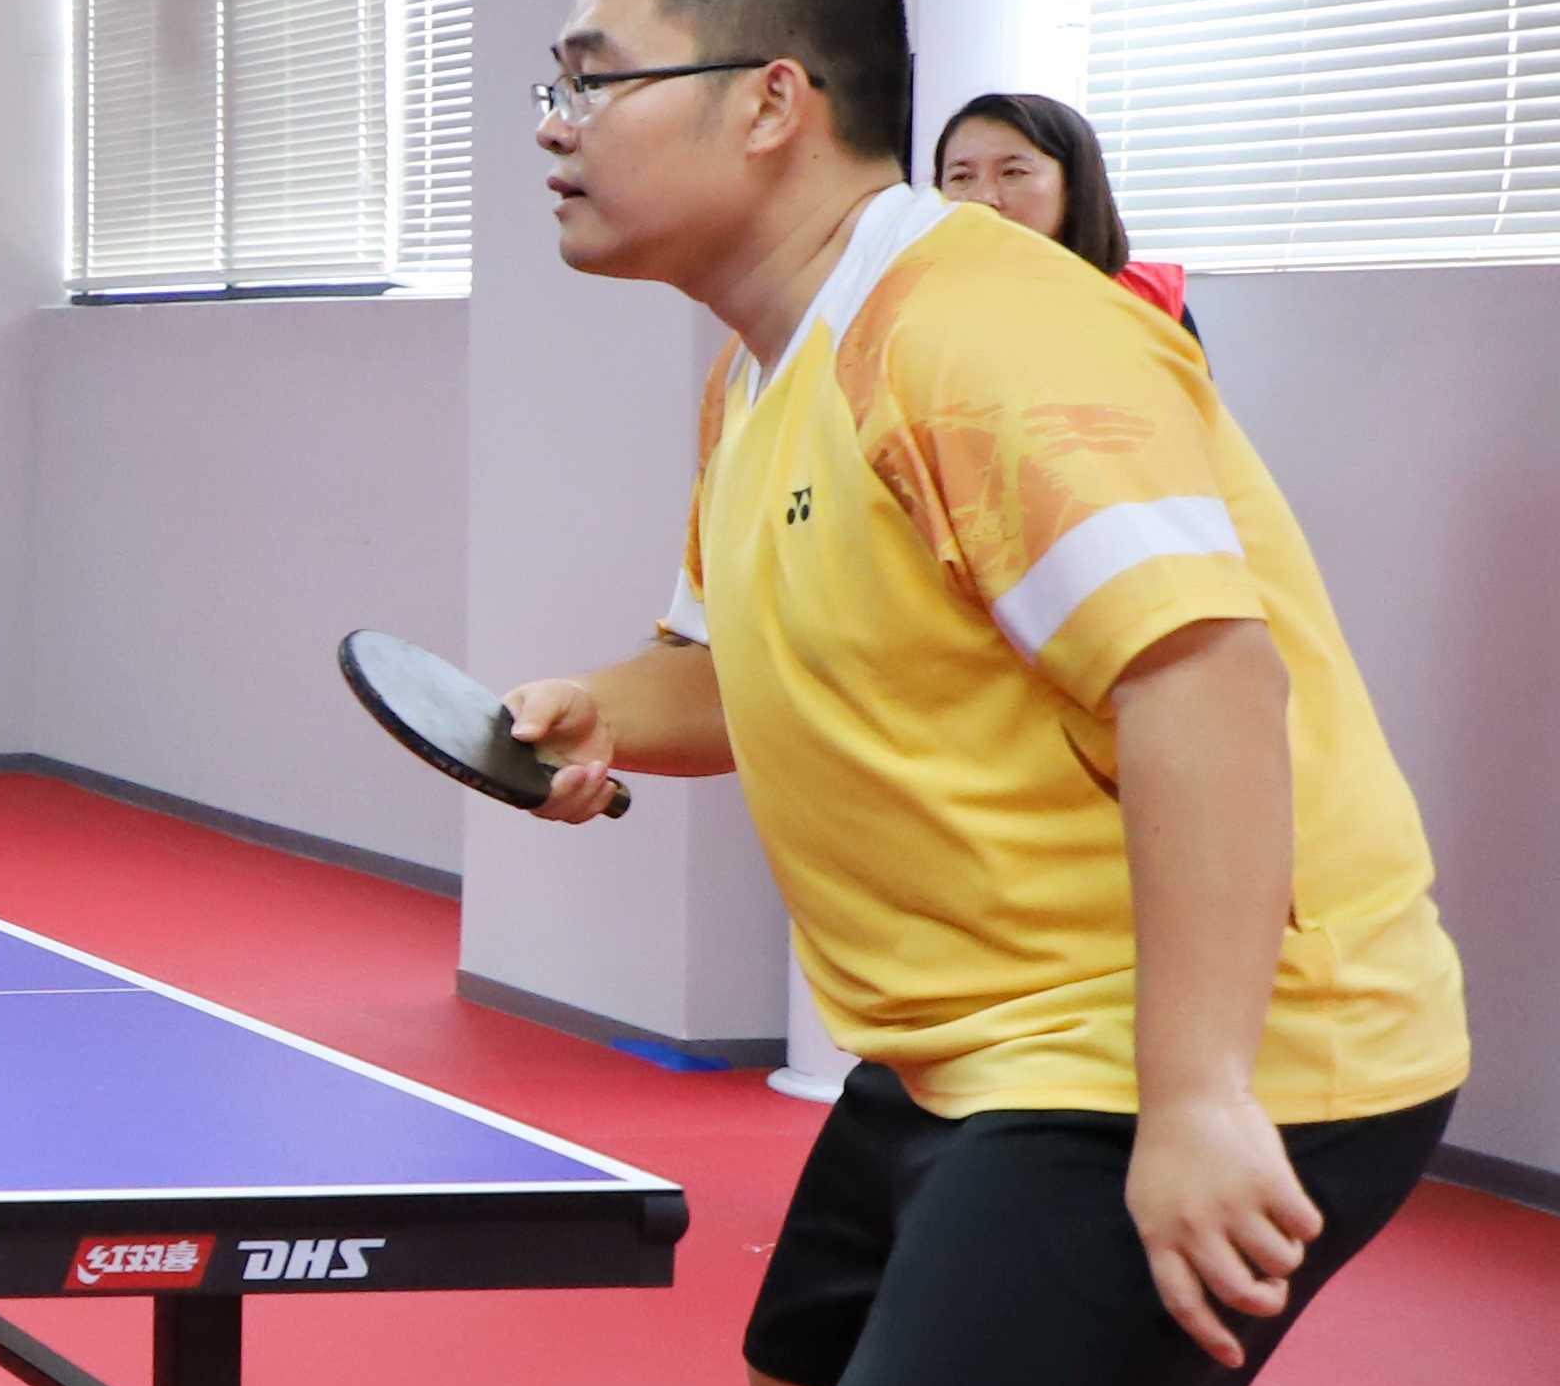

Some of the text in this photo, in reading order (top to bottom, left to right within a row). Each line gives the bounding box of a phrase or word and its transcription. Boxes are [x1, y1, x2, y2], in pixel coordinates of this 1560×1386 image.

[77, 1238, 386, 1284] 红双喜 DHS
